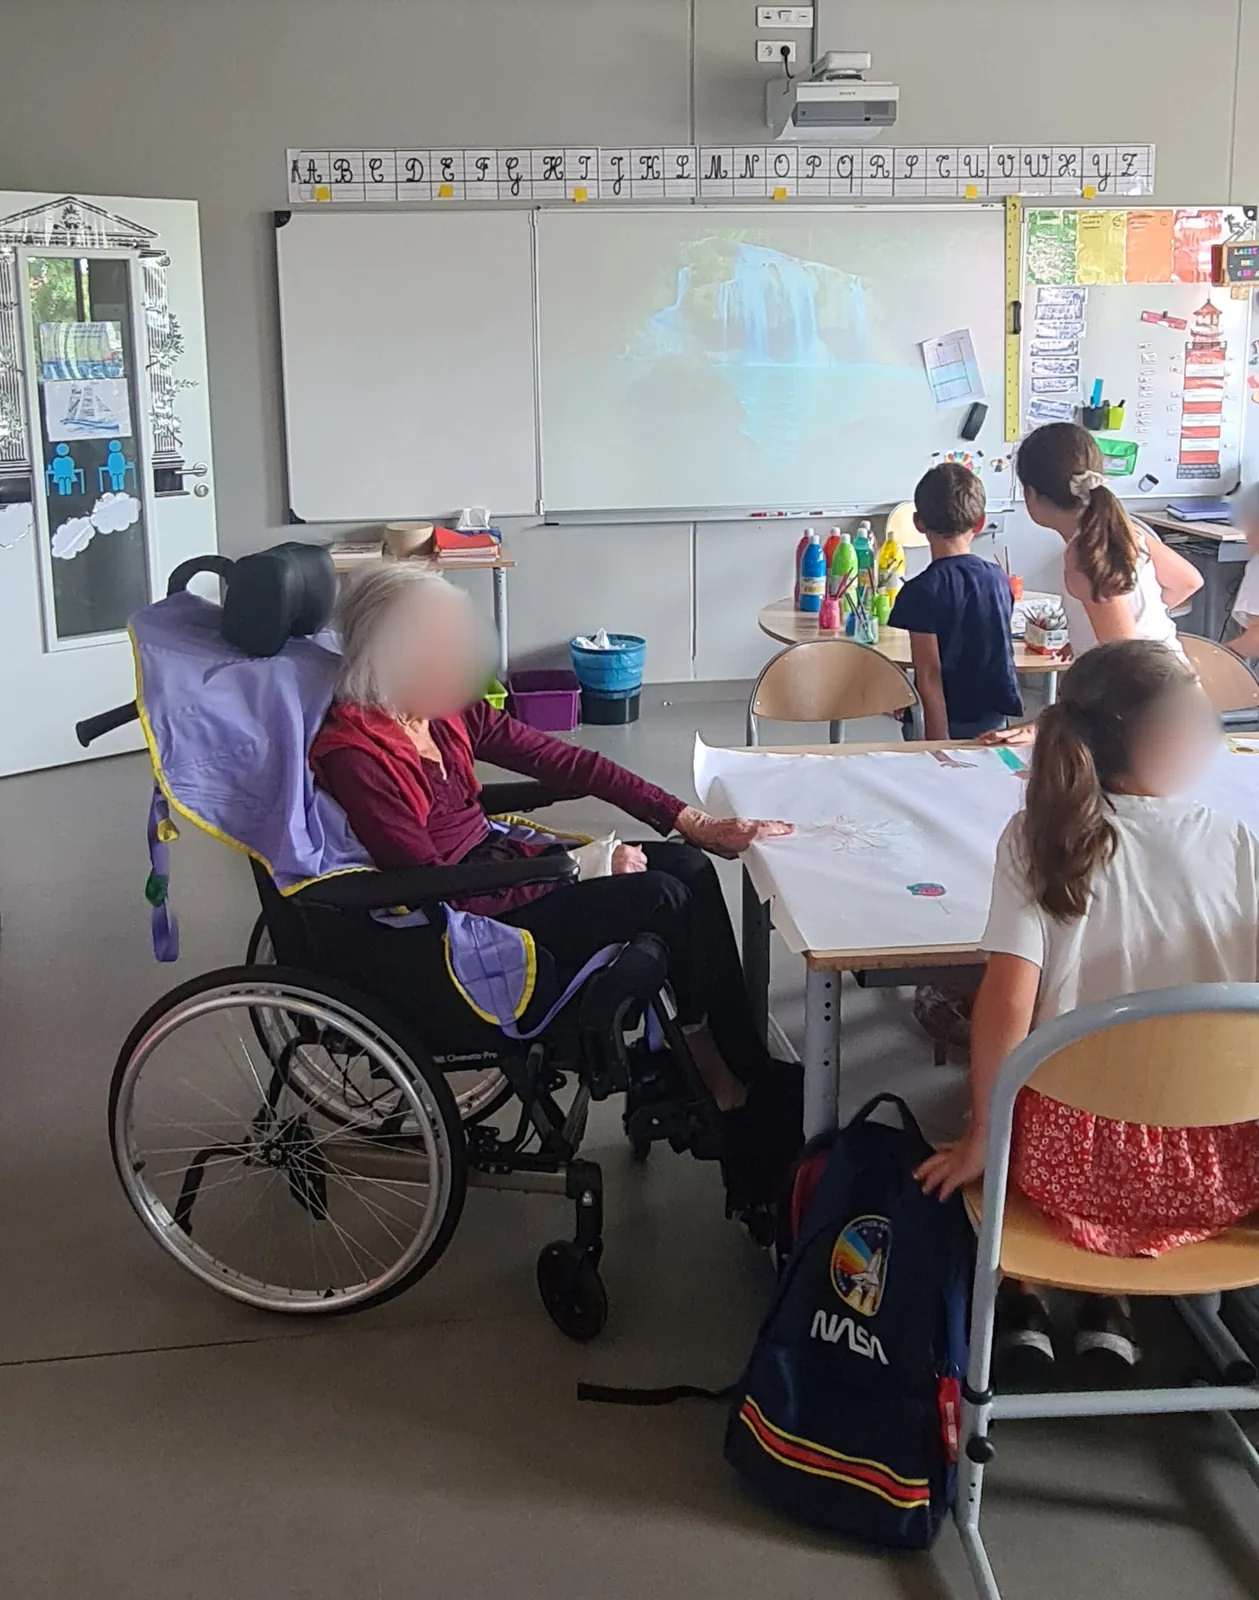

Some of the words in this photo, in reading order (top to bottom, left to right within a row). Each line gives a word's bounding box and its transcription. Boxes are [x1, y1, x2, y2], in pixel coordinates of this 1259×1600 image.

[303, 158, 323, 184] A
[333, 158, 354, 183] B
[368, 157, 385, 183] C
[405, 157, 424, 183] D
[440, 156, 455, 182] E
[475, 156, 491, 182] F
[505, 156, 523, 197] G
[542, 155, 564, 181] H
[610, 156, 624, 196] J
[639, 155, 661, 180] K
[704, 154, 728, 179] M
[740, 154, 760, 179] N
[774, 153, 790, 178] O
[806, 154, 822, 179] P
[836, 154, 854, 194] Q
[869, 154, 891, 179] R
[963, 154, 985, 178] U
[997, 153, 1015, 178] V
[1024, 153, 1050, 178] W
[1058, 153, 1077, 177] X
[1092, 153, 1111, 192] Y
[1121, 153, 1138, 177] Z
[482, 1050, 498, 1060] Pro
[810, 1309, 890, 1365] NASA
